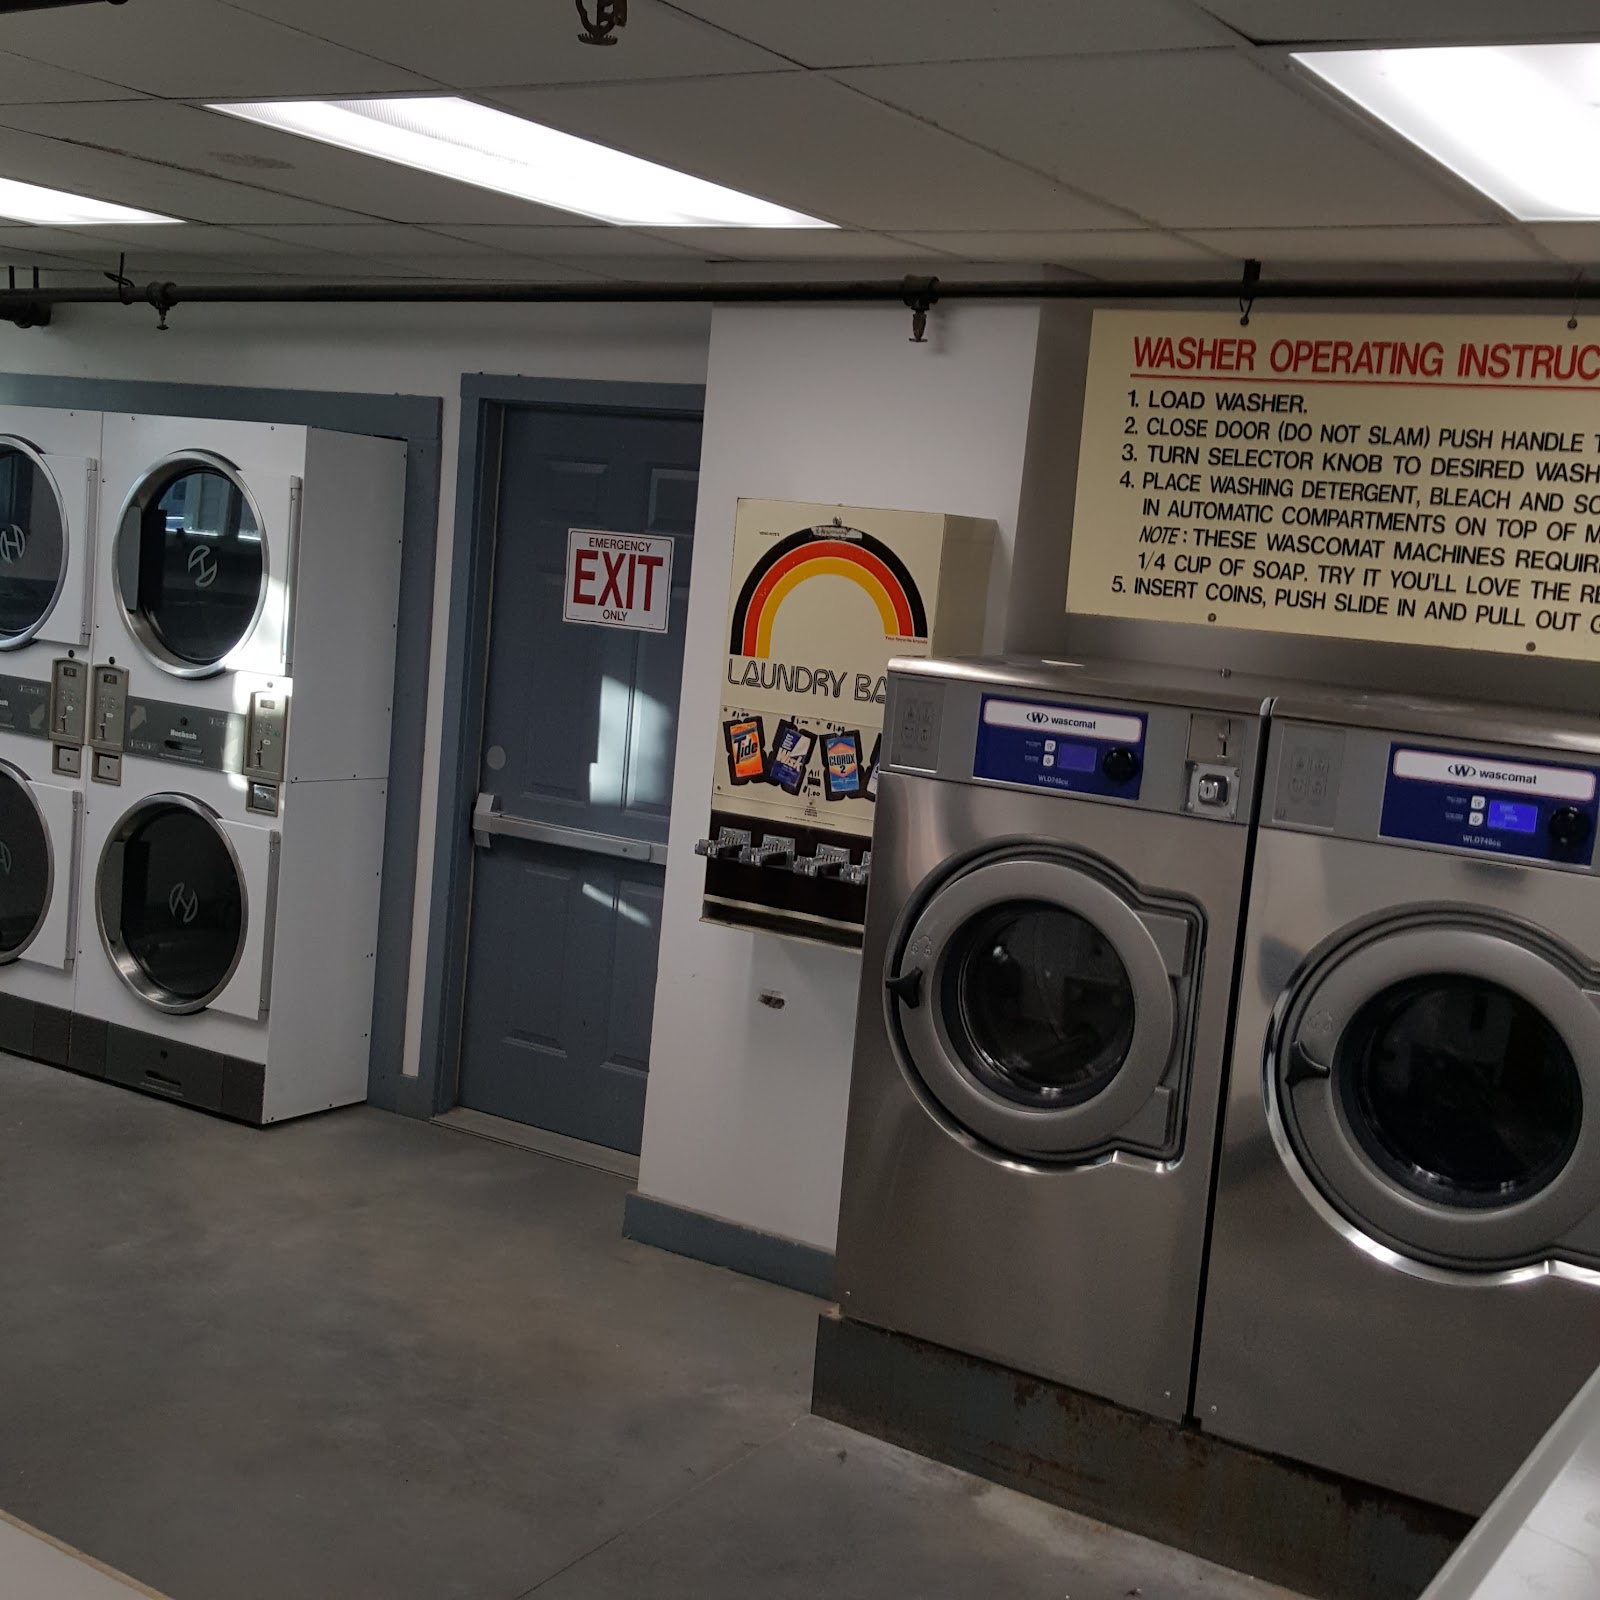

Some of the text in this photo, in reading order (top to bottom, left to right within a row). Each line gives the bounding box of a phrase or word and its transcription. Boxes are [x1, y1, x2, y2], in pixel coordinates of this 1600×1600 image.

[1134, 335, 1600, 380] WASHER OPERATING INSTRUC
[1127, 389, 1308, 414] 1. LOAD WASHER.
[1124, 415, 1138, 435] 2.
[1146, 417, 1208, 437] CLOSE
[1215, 420, 1271, 439] DOOR
[1278, 420, 1313, 443] (DO
[1320, 424, 1361, 445] NOT
[1368, 425, 1430, 448] SLAM)
[1438, 428, 1494, 449] PUSH
[1501, 430, 1585, 453] HANDLE
[1121, 443, 1138, 462] 3.
[1147, 444, 1200, 465] TURN
[1207, 447, 1314, 470] SELECTOR
[1322, 452, 1383, 474] KNOB
[1393, 455, 1422, 475] TO
[1430, 457, 1525, 480] DESIRED
[1119, 470, 1136, 490] 4.
[1142, 472, 1202, 492] PLACE
[1210, 475, 1294, 498] WASHING
[1301, 480, 1421, 509] DETERGENT,
[1429, 486, 1512, 510] BLEACH
[1519, 492, 1565, 512] AND
[1142, 498, 1161, 516] IN
[1167, 500, 1274, 523] AUTOMATIC
[1282, 505, 1447, 534] COMPARTMENTS
[1455, 516, 1487, 537] ON
[1496, 518, 1538, 540] TOP
[1546, 521, 1578, 543] OF
[588, 537, 652, 553] EMERGENCY
[1192, 528, 1258, 550] THESE
[1266, 532, 1386, 560] WASCOMAT
[1393, 541, 1506, 567] MACHINES
[573, 549, 664, 612] EXIT
[1138, 551, 1166, 571] 1/4
[1174, 554, 1212, 574] CUP
[1219, 557, 1246, 577] OF
[1252, 560, 1309, 582] SOAP.
[1317, 564, 1356, 586] TRY
[1363, 568, 1382, 588] IT
[1390, 569, 1457, 594] YOU'LL
[1466, 576, 1521, 598] LOVE
[1531, 580, 1572, 602] THE
[602, 609, 628, 622] ONLY
[1111, 575, 1127, 594] 5.
[1134, 576, 1199, 599] INSERT
[1205, 582, 1266, 608] COINS,
[1274, 588, 1326, 611] PUSH
[1333, 592, 1390, 615] SLIDE
[1397, 598, 1416, 618] IN
[1424, 601, 1467, 622] AND
[1476, 605, 1526, 627] PULL
[1536, 609, 1582, 632] OUT
[727, 658, 848, 698] LAUNDRY
[1051, 716, 1096, 730] wascomat
[733, 735, 758, 765] Tide
[828, 753, 856, 767] CLOROX
[839, 764, 847, 774] 2
[1479, 769, 1537, 785] wascomat
